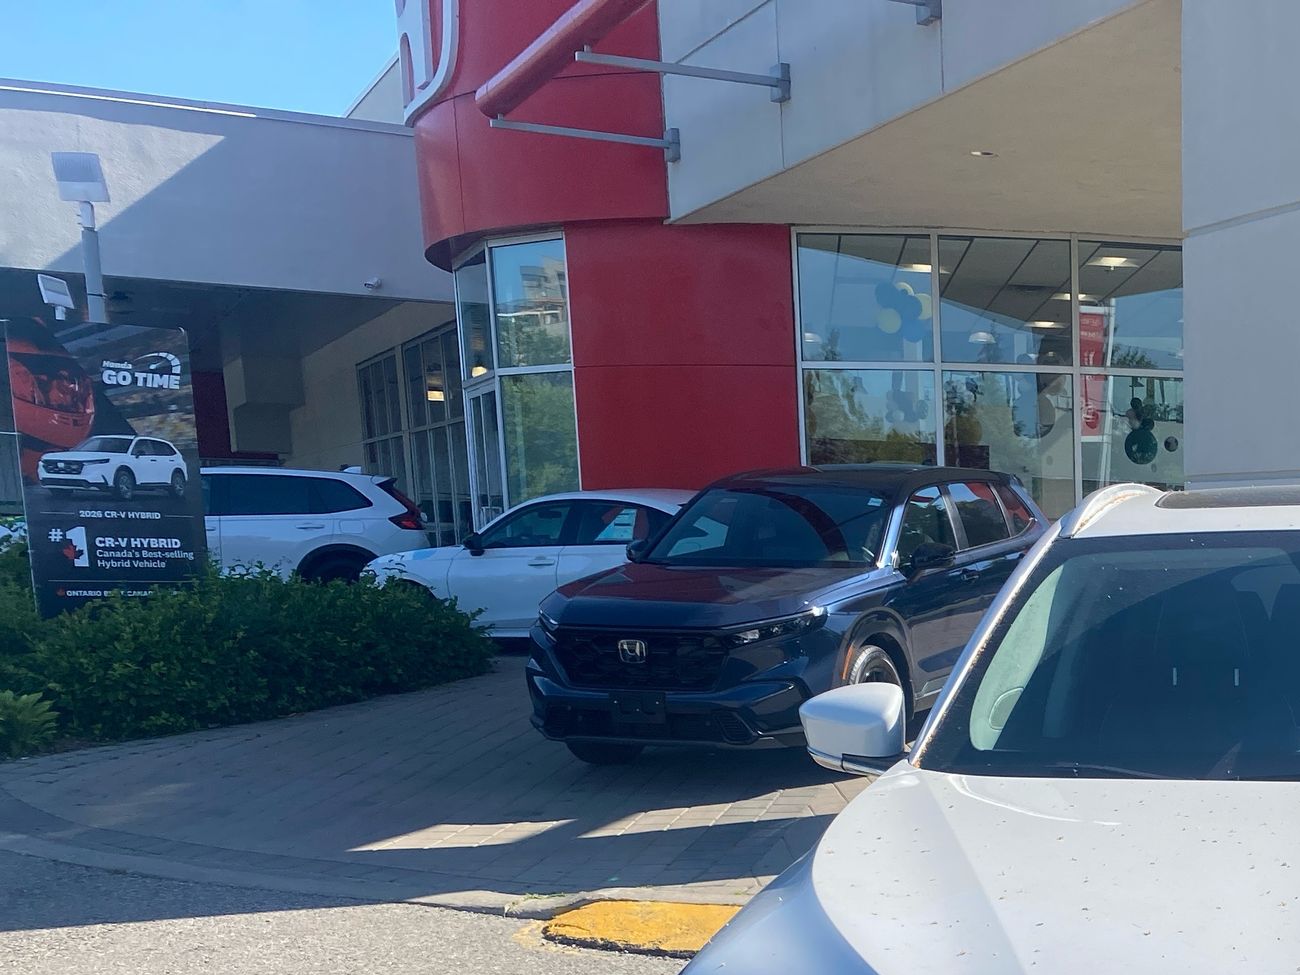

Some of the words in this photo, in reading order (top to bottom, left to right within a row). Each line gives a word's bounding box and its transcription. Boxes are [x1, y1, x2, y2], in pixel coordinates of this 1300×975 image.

[102, 360, 132, 369] Honda
[102, 369, 132, 386] GO
[135, 372, 180, 390] TIME
[79, 510, 103, 518] 2026
[104, 511, 126, 519] CR-V
[128, 511, 161, 520] HYBRID
[95, 537, 128, 547] CR-V
[130, 537, 181, 548] HYBRID
[96, 549, 140, 558] Canada's
[142, 550, 194, 560] Best-selling
[97, 559, 131, 569] Hybrid
